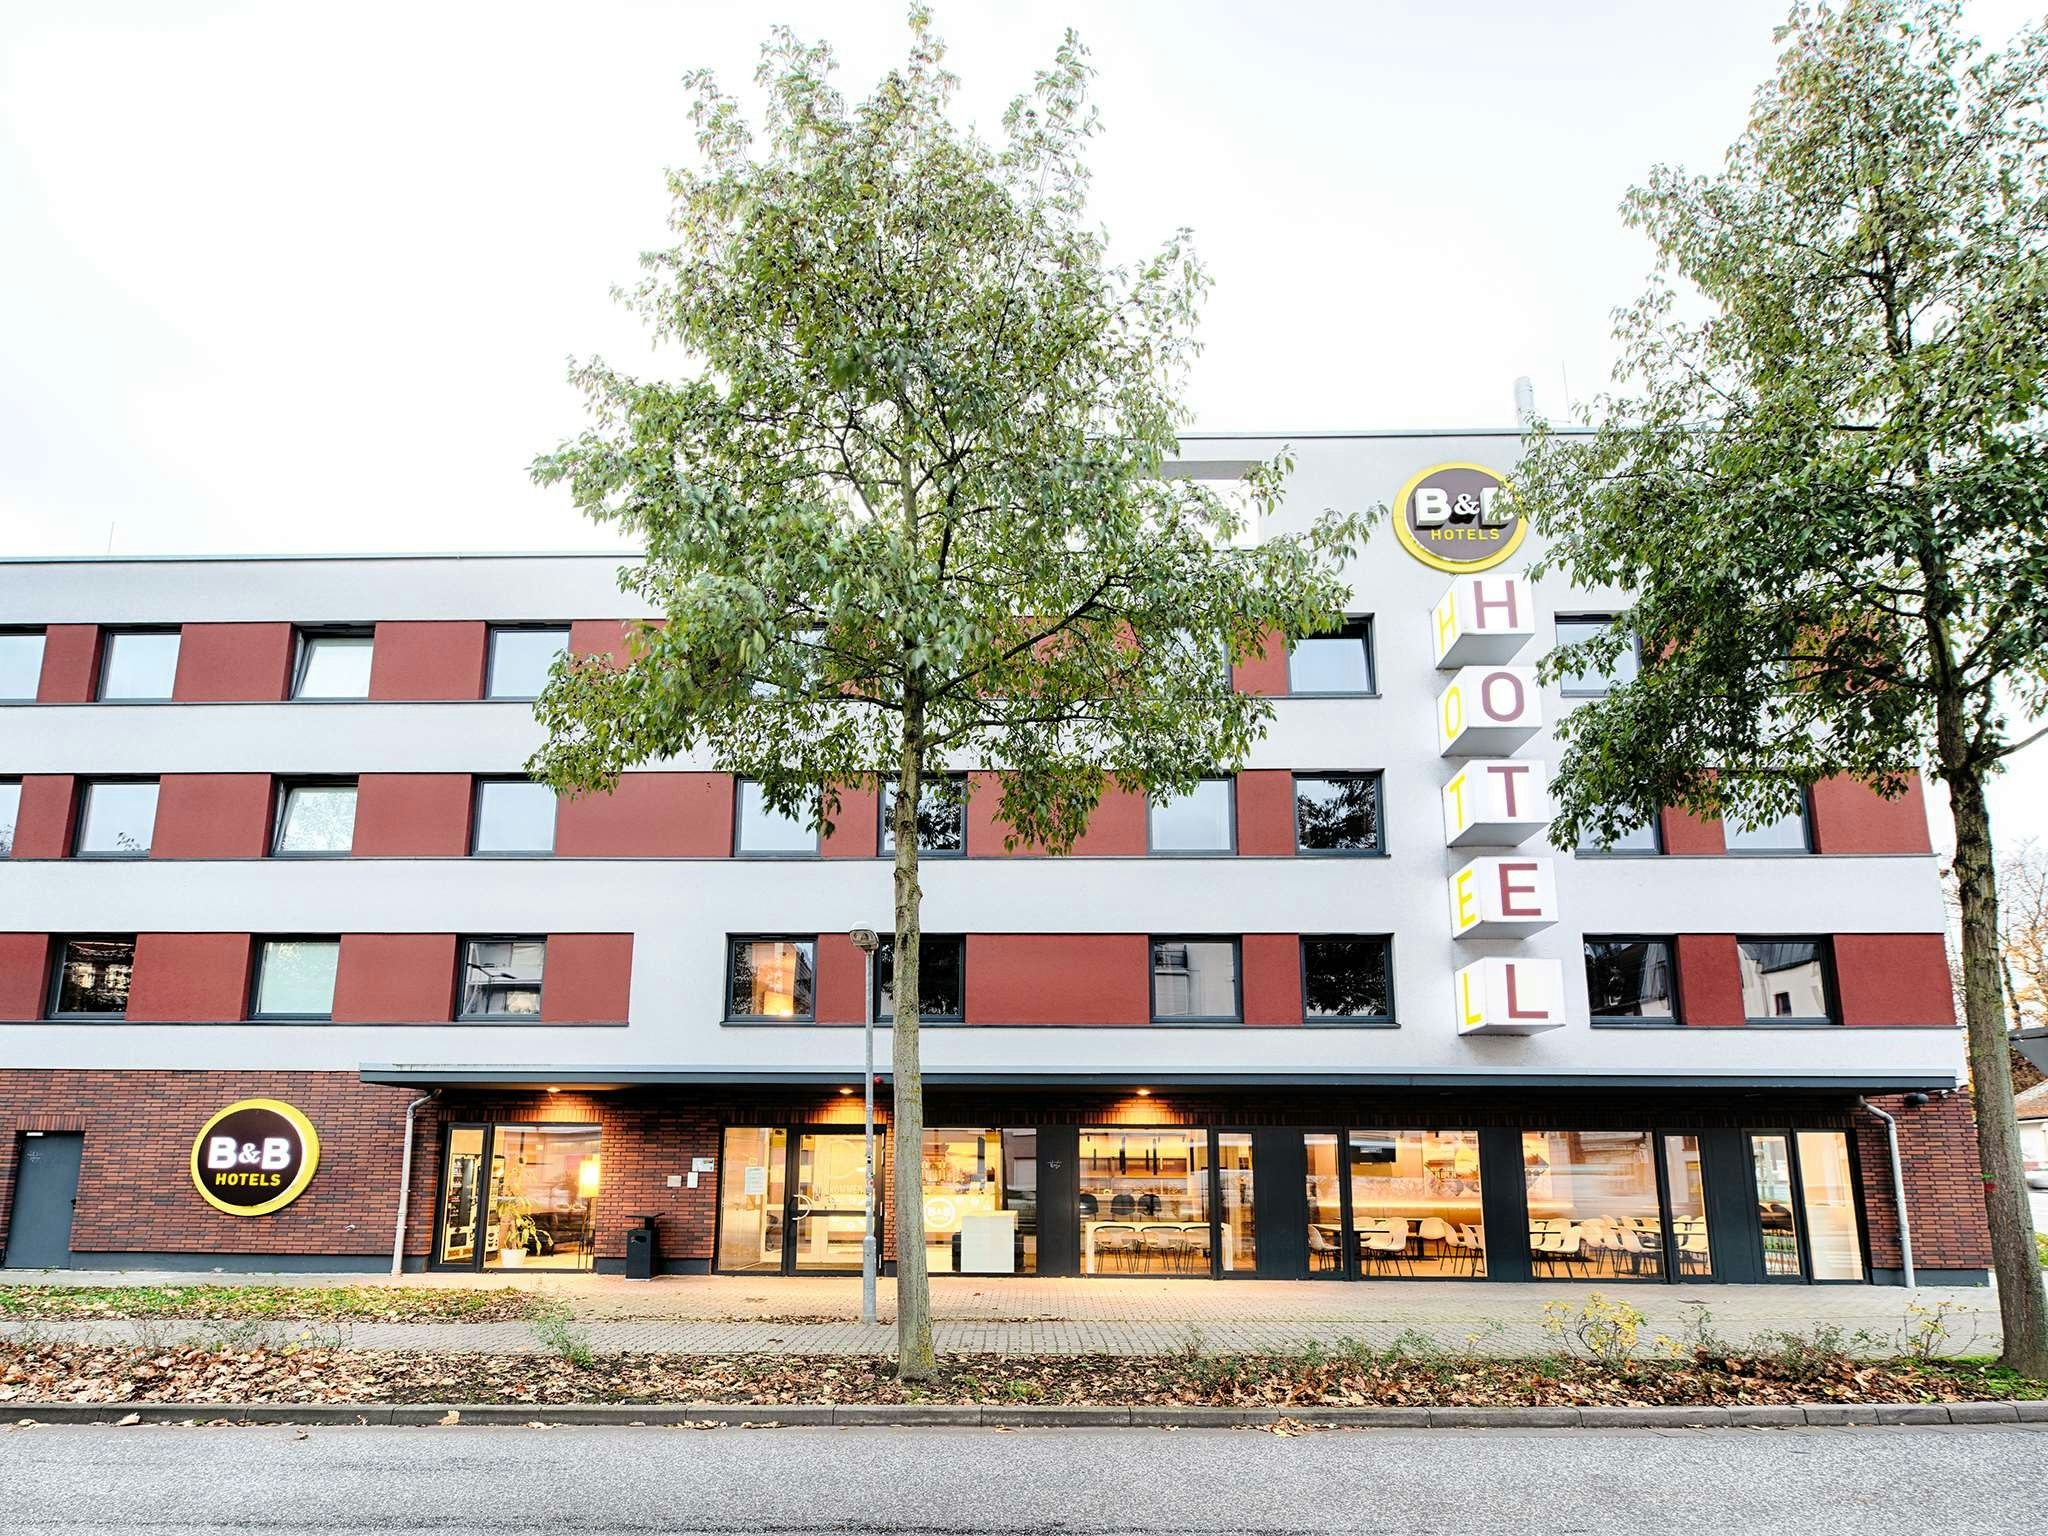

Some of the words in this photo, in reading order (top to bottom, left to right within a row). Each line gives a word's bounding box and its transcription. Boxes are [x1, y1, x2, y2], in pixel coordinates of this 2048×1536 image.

[1431, 528, 1500, 540] HOTELS
[1439, 592, 1482, 1025] HOTEL
[1473, 580, 1549, 1019] HOTEL
[207, 1137, 291, 1170] B&B
[215, 1173, 281, 1186] HOTELS
